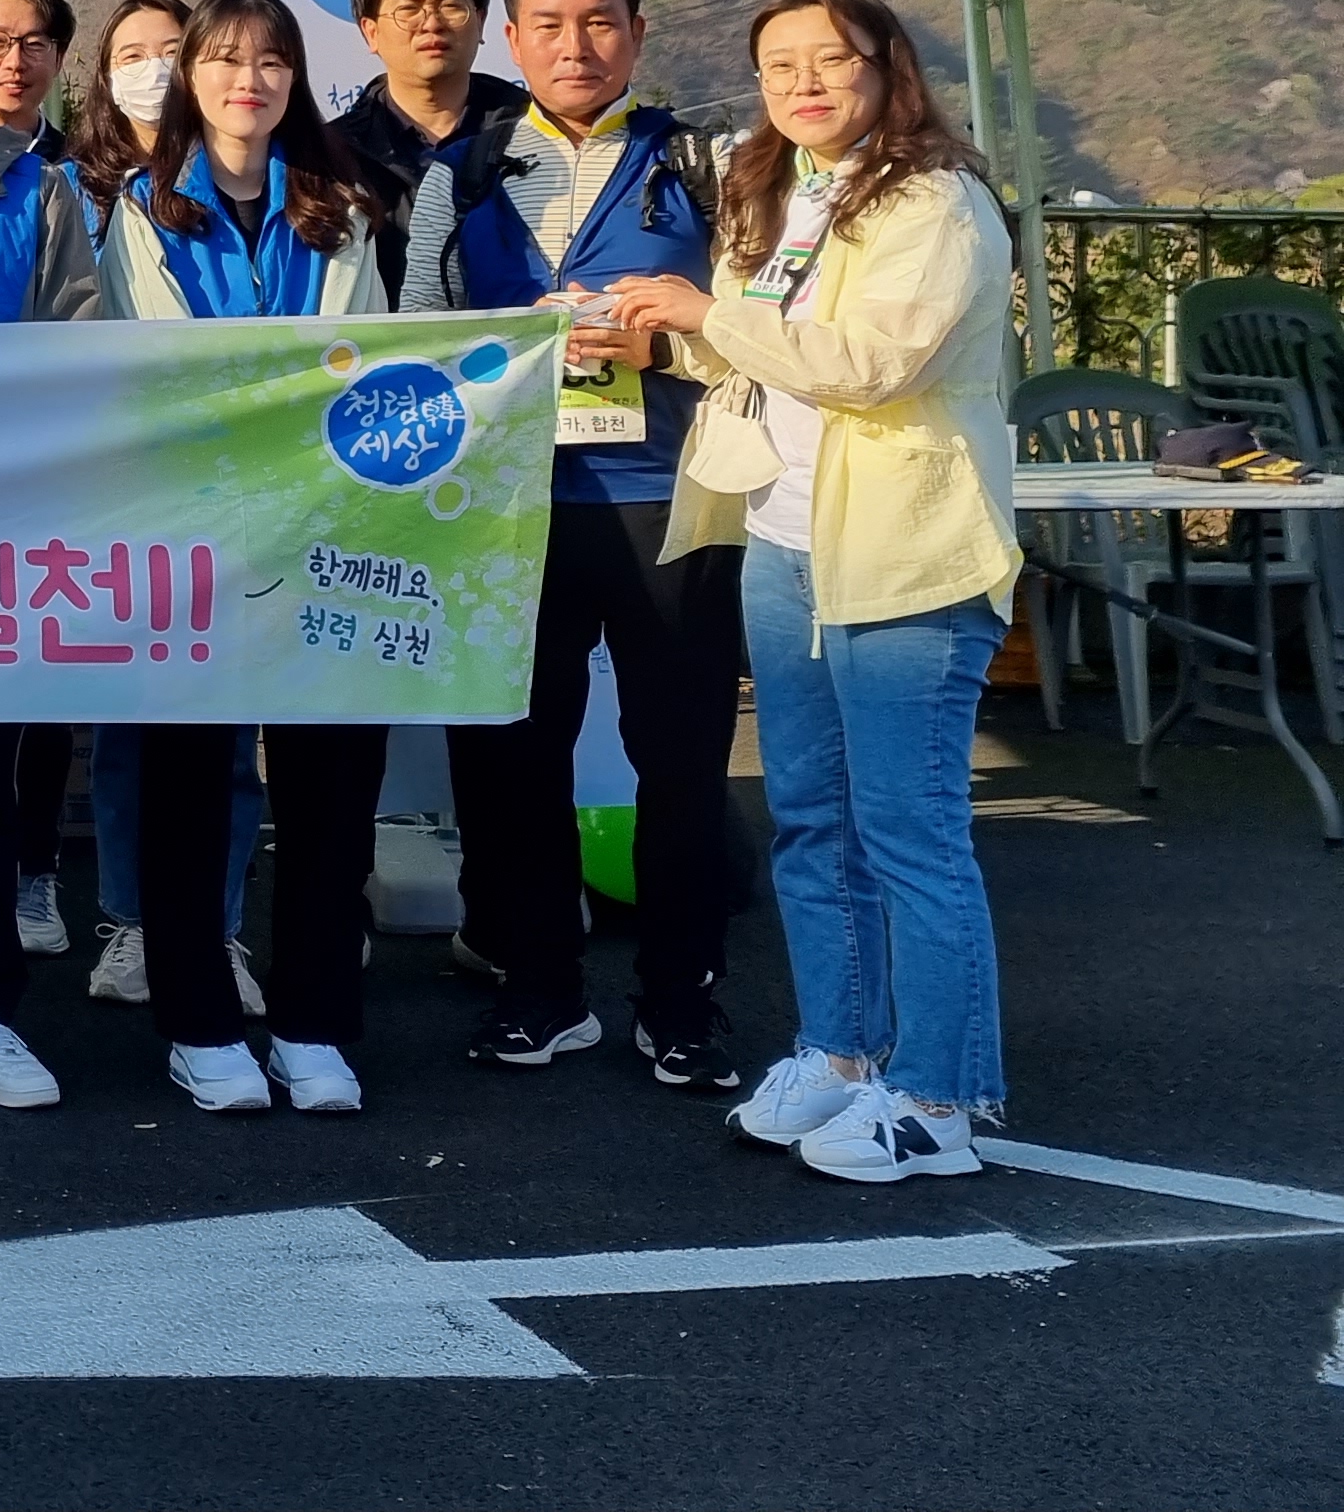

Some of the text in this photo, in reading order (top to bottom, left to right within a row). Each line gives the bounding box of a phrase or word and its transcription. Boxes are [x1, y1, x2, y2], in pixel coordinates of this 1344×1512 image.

[327, 83, 365, 115] 청
[752, 282, 785, 294] DREA
[557, 415, 626, 434] 카, 합천
[349, 423, 439, 471] 세상
[299, 605, 432, 666] 청렴 실천
